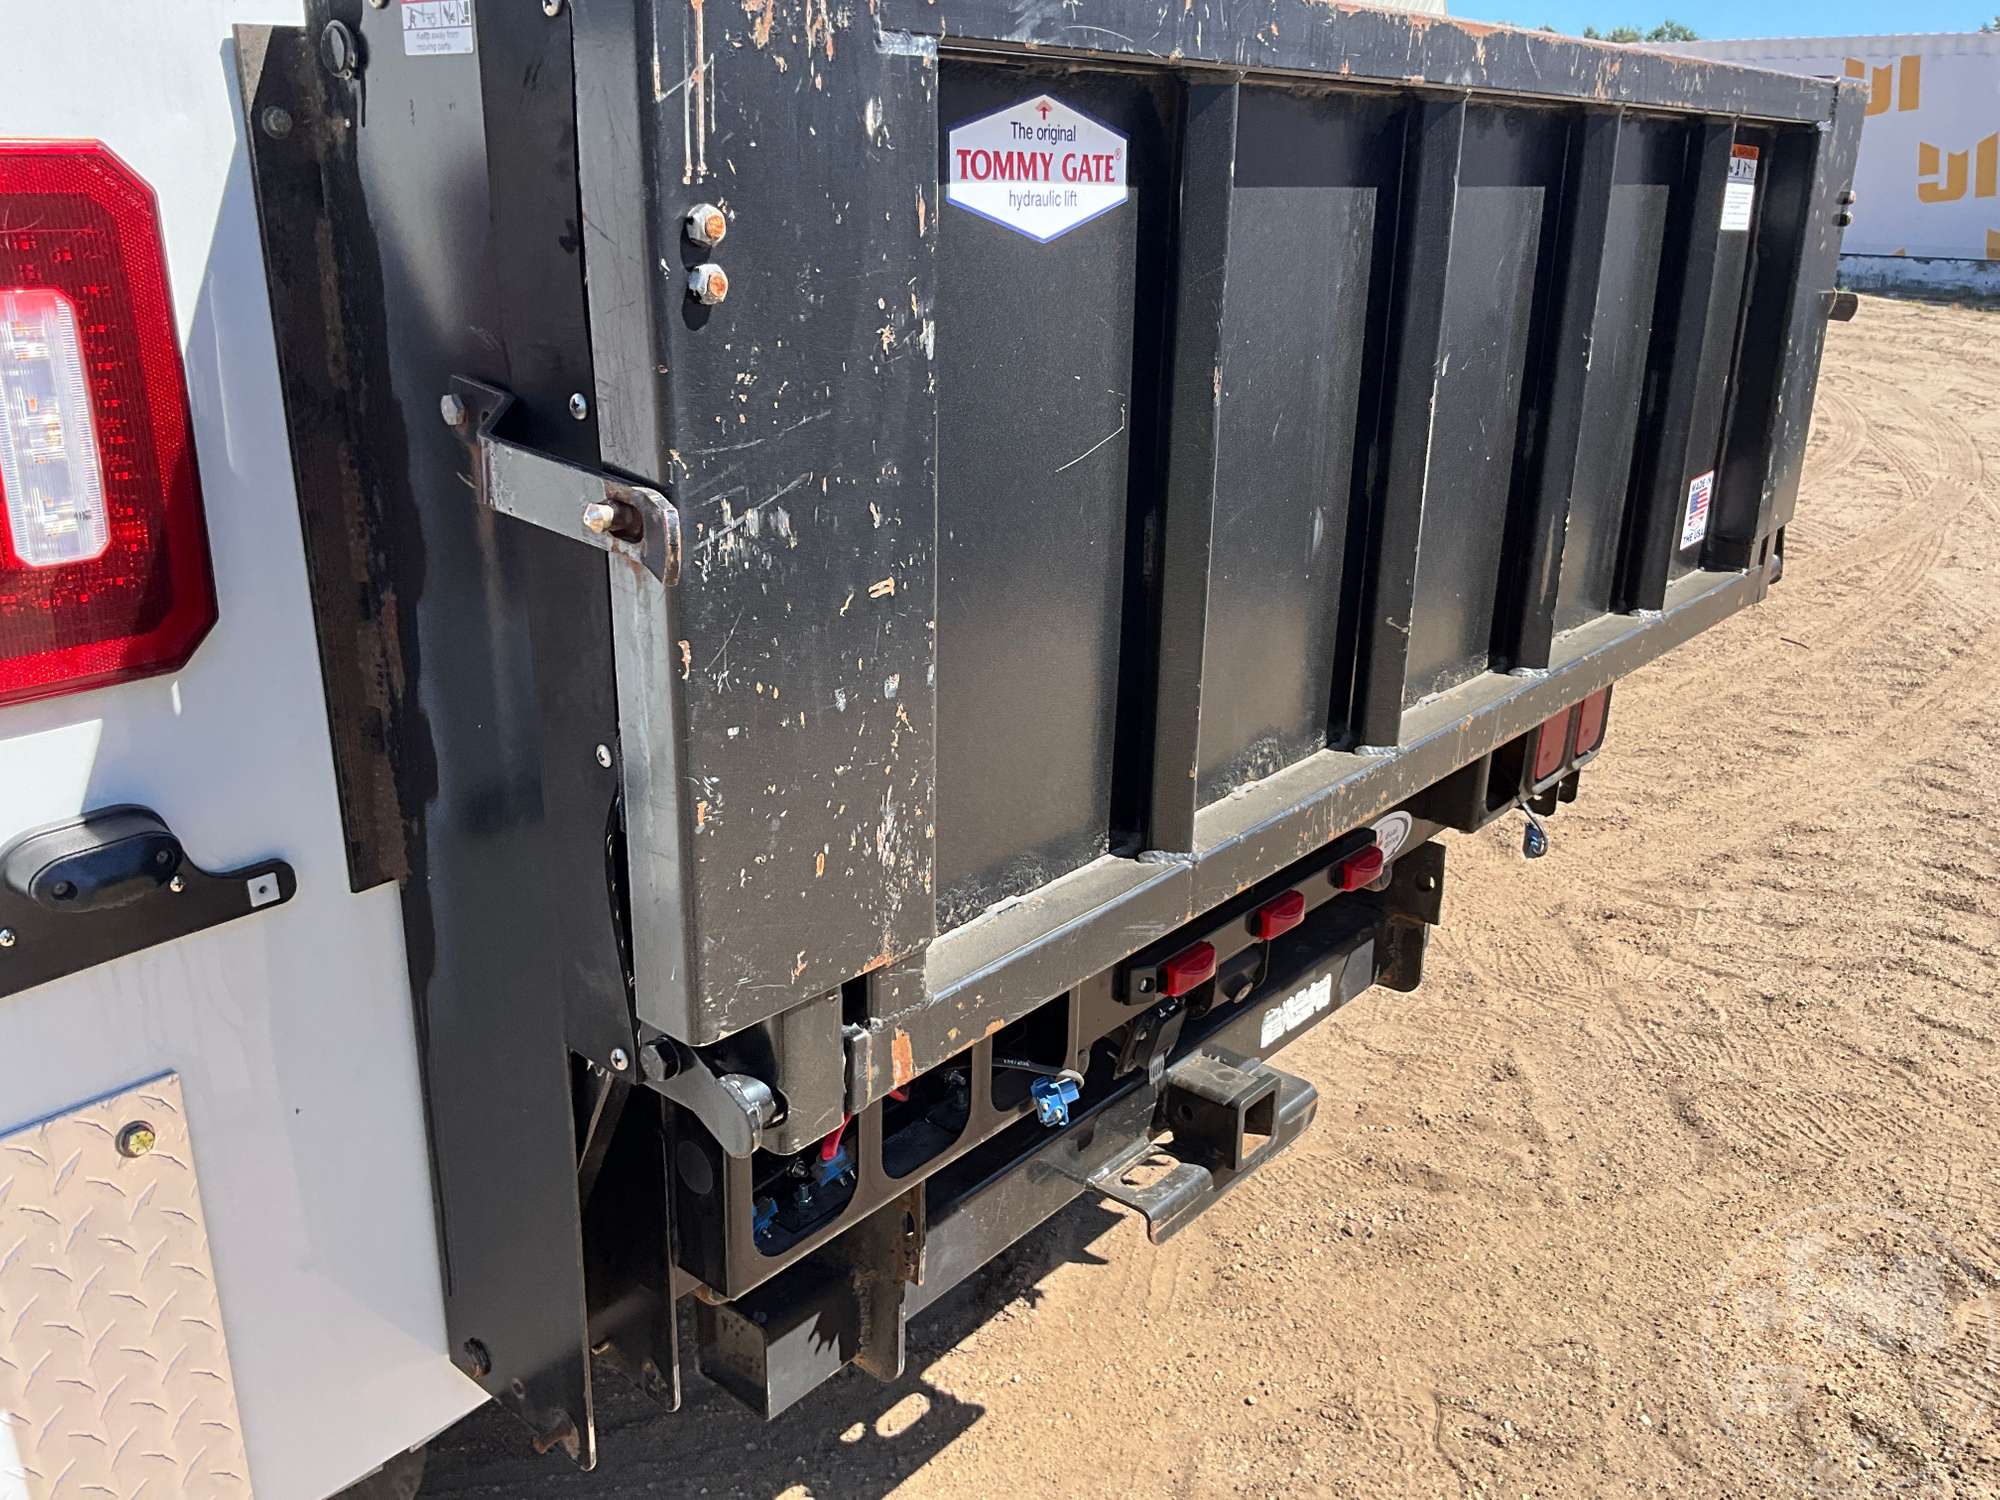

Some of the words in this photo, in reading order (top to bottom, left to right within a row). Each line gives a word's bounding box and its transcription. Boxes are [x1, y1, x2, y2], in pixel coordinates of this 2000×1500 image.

[1010, 121, 1033, 141] The
[1036, 124, 1077, 145] original
[956, 149, 1054, 181] TOMMY
[1008, 190, 1062, 211] hydraulic
[1064, 190, 1077, 207] lift
[1683, 532, 1694, 544] THE
